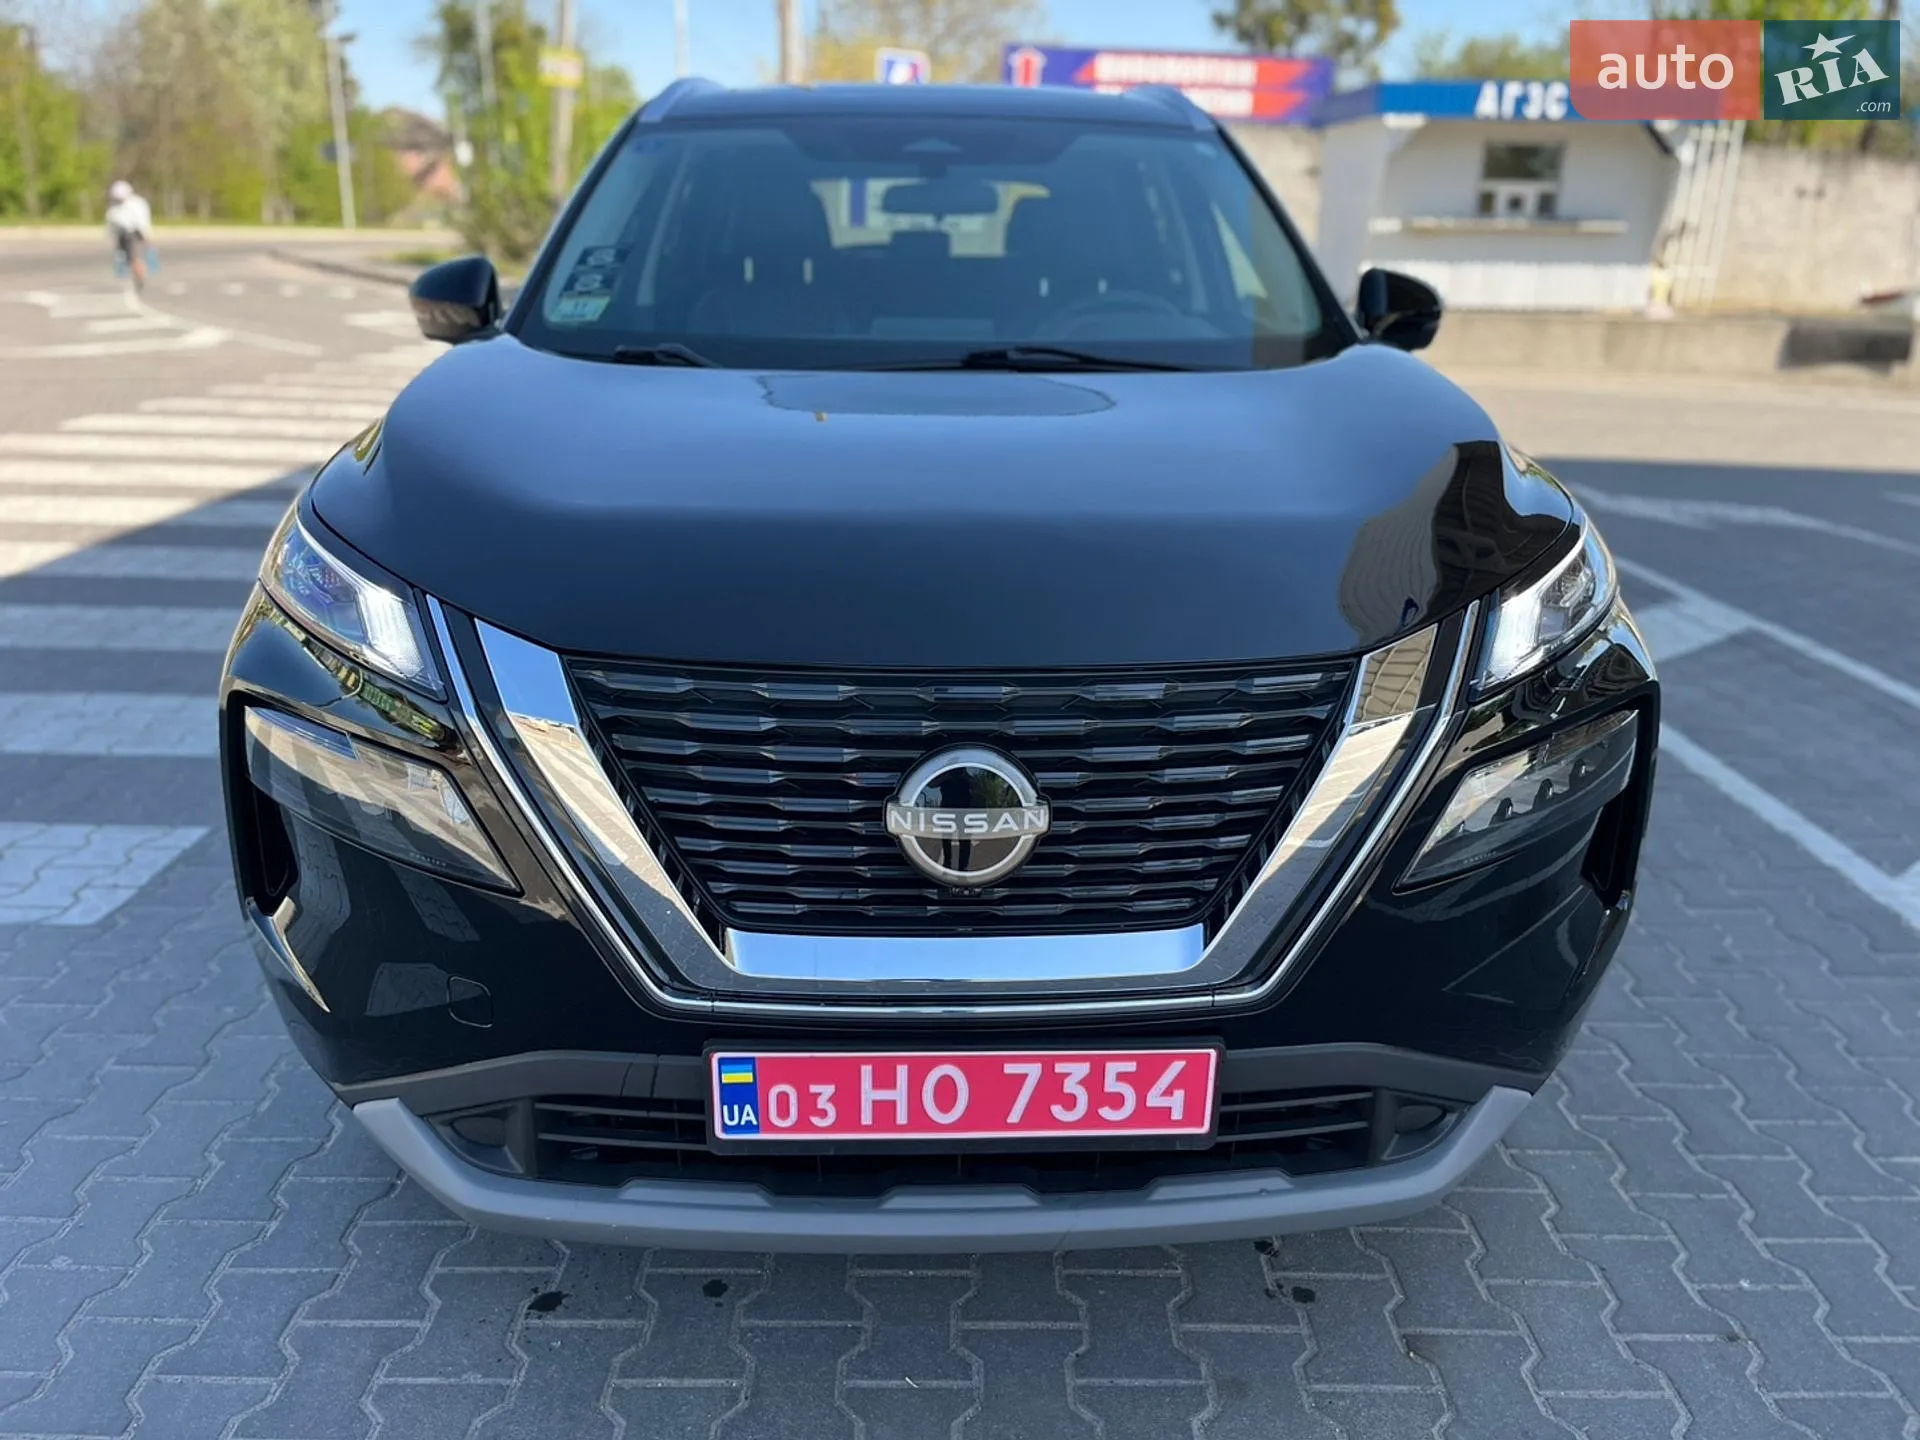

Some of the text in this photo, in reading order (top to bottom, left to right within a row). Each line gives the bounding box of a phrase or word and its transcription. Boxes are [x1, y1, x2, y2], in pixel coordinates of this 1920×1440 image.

[890, 808, 1045, 834] NISSAN
[768, 1060, 1186, 1128] 03 HO 7354
[723, 1104, 758, 1126] UA
